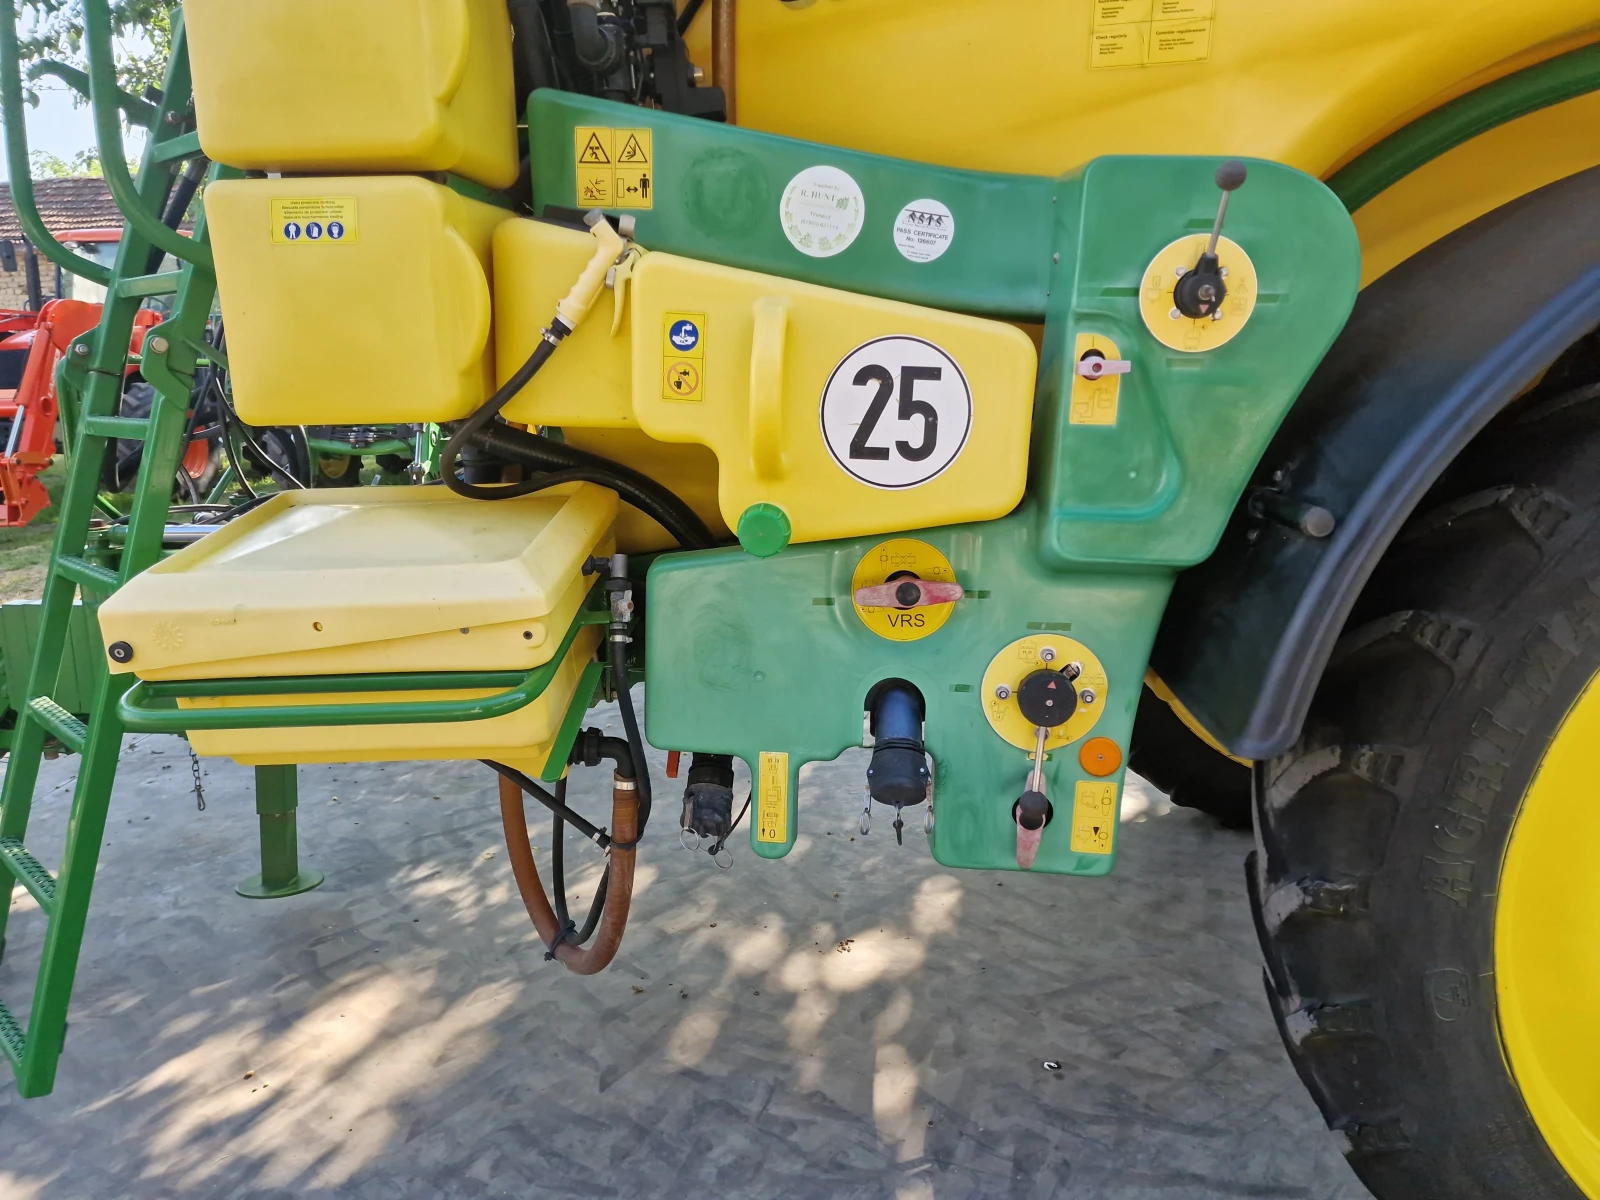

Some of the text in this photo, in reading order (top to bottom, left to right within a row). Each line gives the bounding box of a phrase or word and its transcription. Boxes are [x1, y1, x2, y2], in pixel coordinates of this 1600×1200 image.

[800, 189, 837, 202] R. HUNT
[896, 227, 949, 241] PASS CERTIFICATE
[849, 364, 942, 462] 25
[887, 613, 926, 627] VRS
